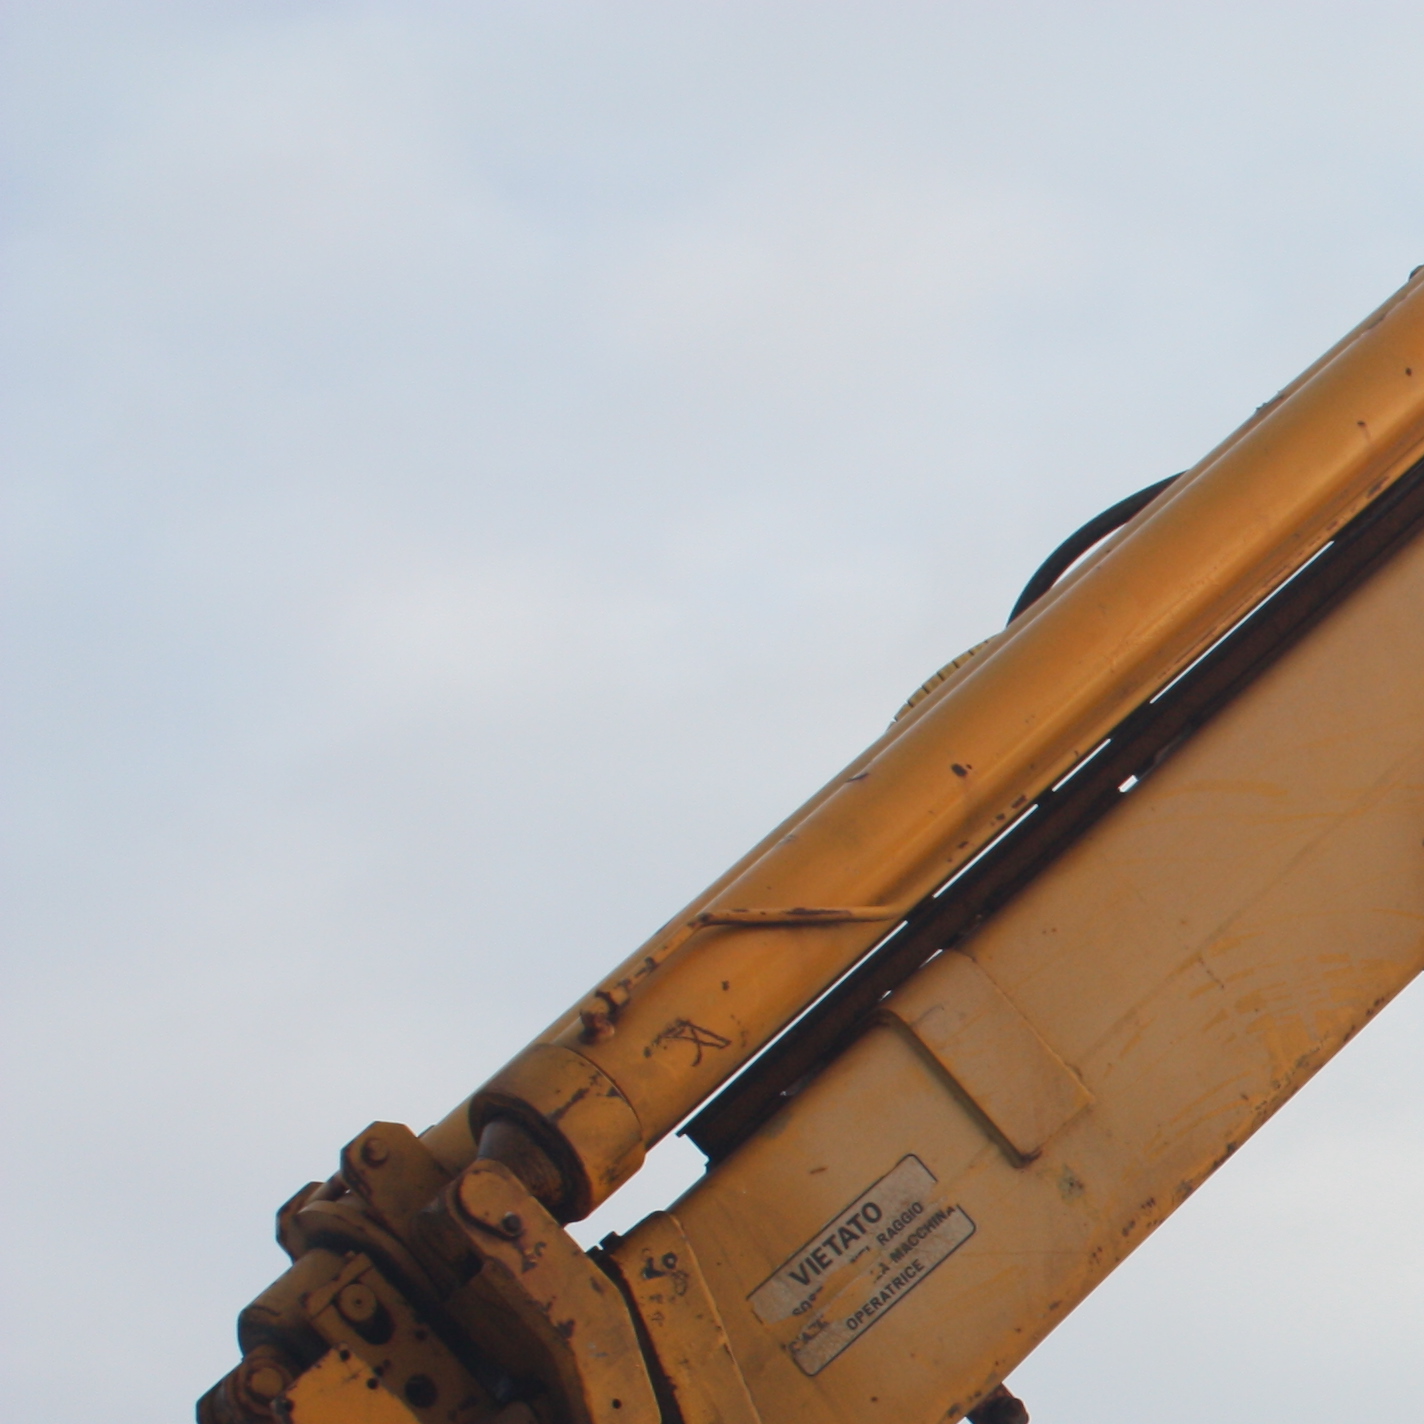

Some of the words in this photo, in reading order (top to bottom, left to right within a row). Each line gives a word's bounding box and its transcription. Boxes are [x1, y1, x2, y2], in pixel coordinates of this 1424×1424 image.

[788, 1202, 882, 1286] VIETATO
[876, 1201, 924, 1246] RAGGIO
[890, 1206, 955, 1263] MACCHINA
[846, 1259, 925, 1331] OPERATRICE
